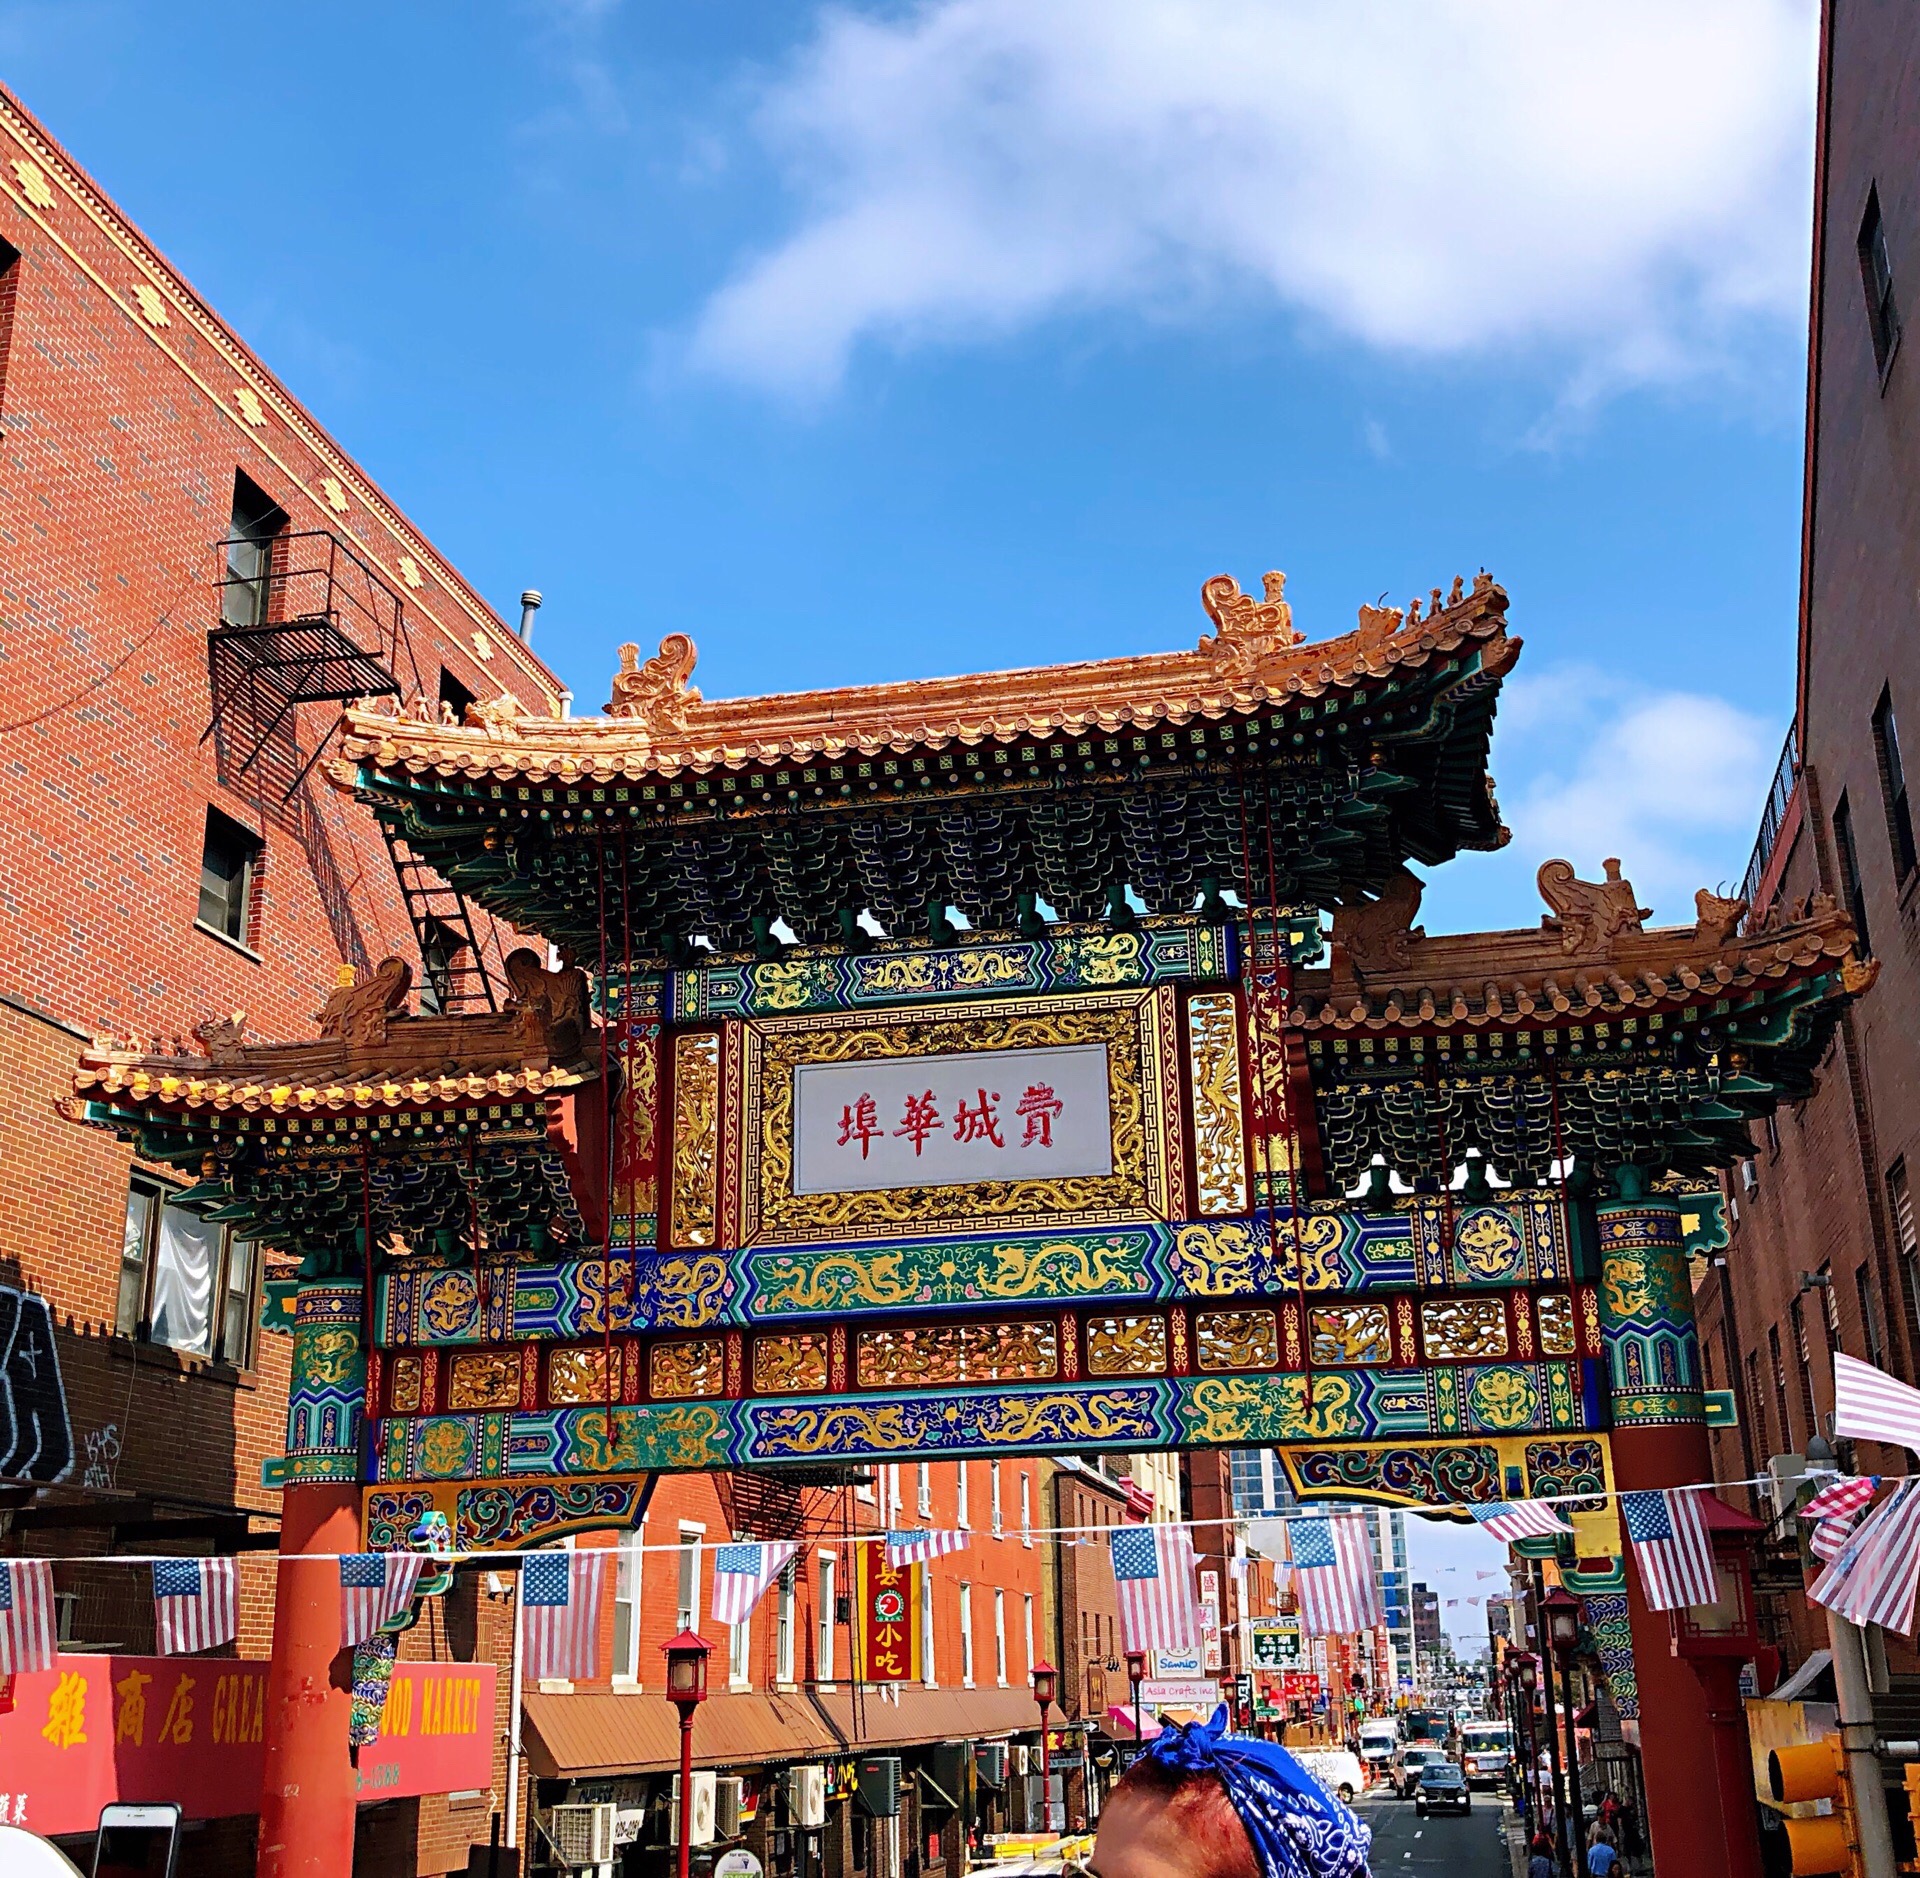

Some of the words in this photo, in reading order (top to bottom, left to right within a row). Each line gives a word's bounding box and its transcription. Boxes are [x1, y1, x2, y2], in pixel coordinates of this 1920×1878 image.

[1159, 1658, 1198, 1669] Sanrio
[1146, 1686, 1166, 1696] Asia
[1199, 1686, 1216, 1695] Inc.
[212, 1674, 266, 1744] GREA
[380, 1677, 413, 1737] OOD
[420, 1677, 481, 1736] MARKET
